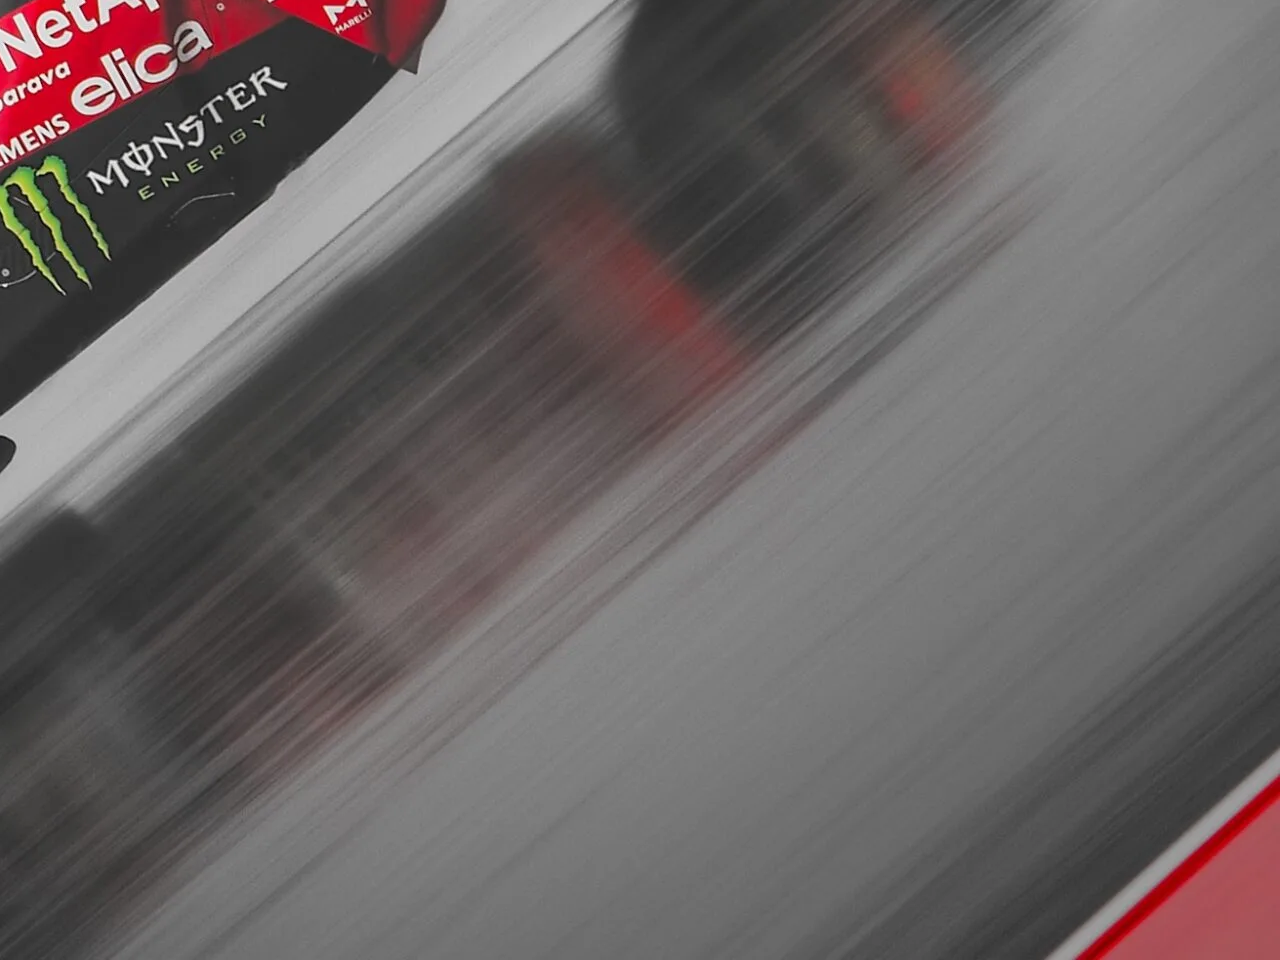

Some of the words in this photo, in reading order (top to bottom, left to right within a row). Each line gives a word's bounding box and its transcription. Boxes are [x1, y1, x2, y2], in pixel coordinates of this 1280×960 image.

[70, 20, 213, 116] elica
[86, 65, 288, 195] MONSTER
[137, 113, 268, 202] ENERGY
